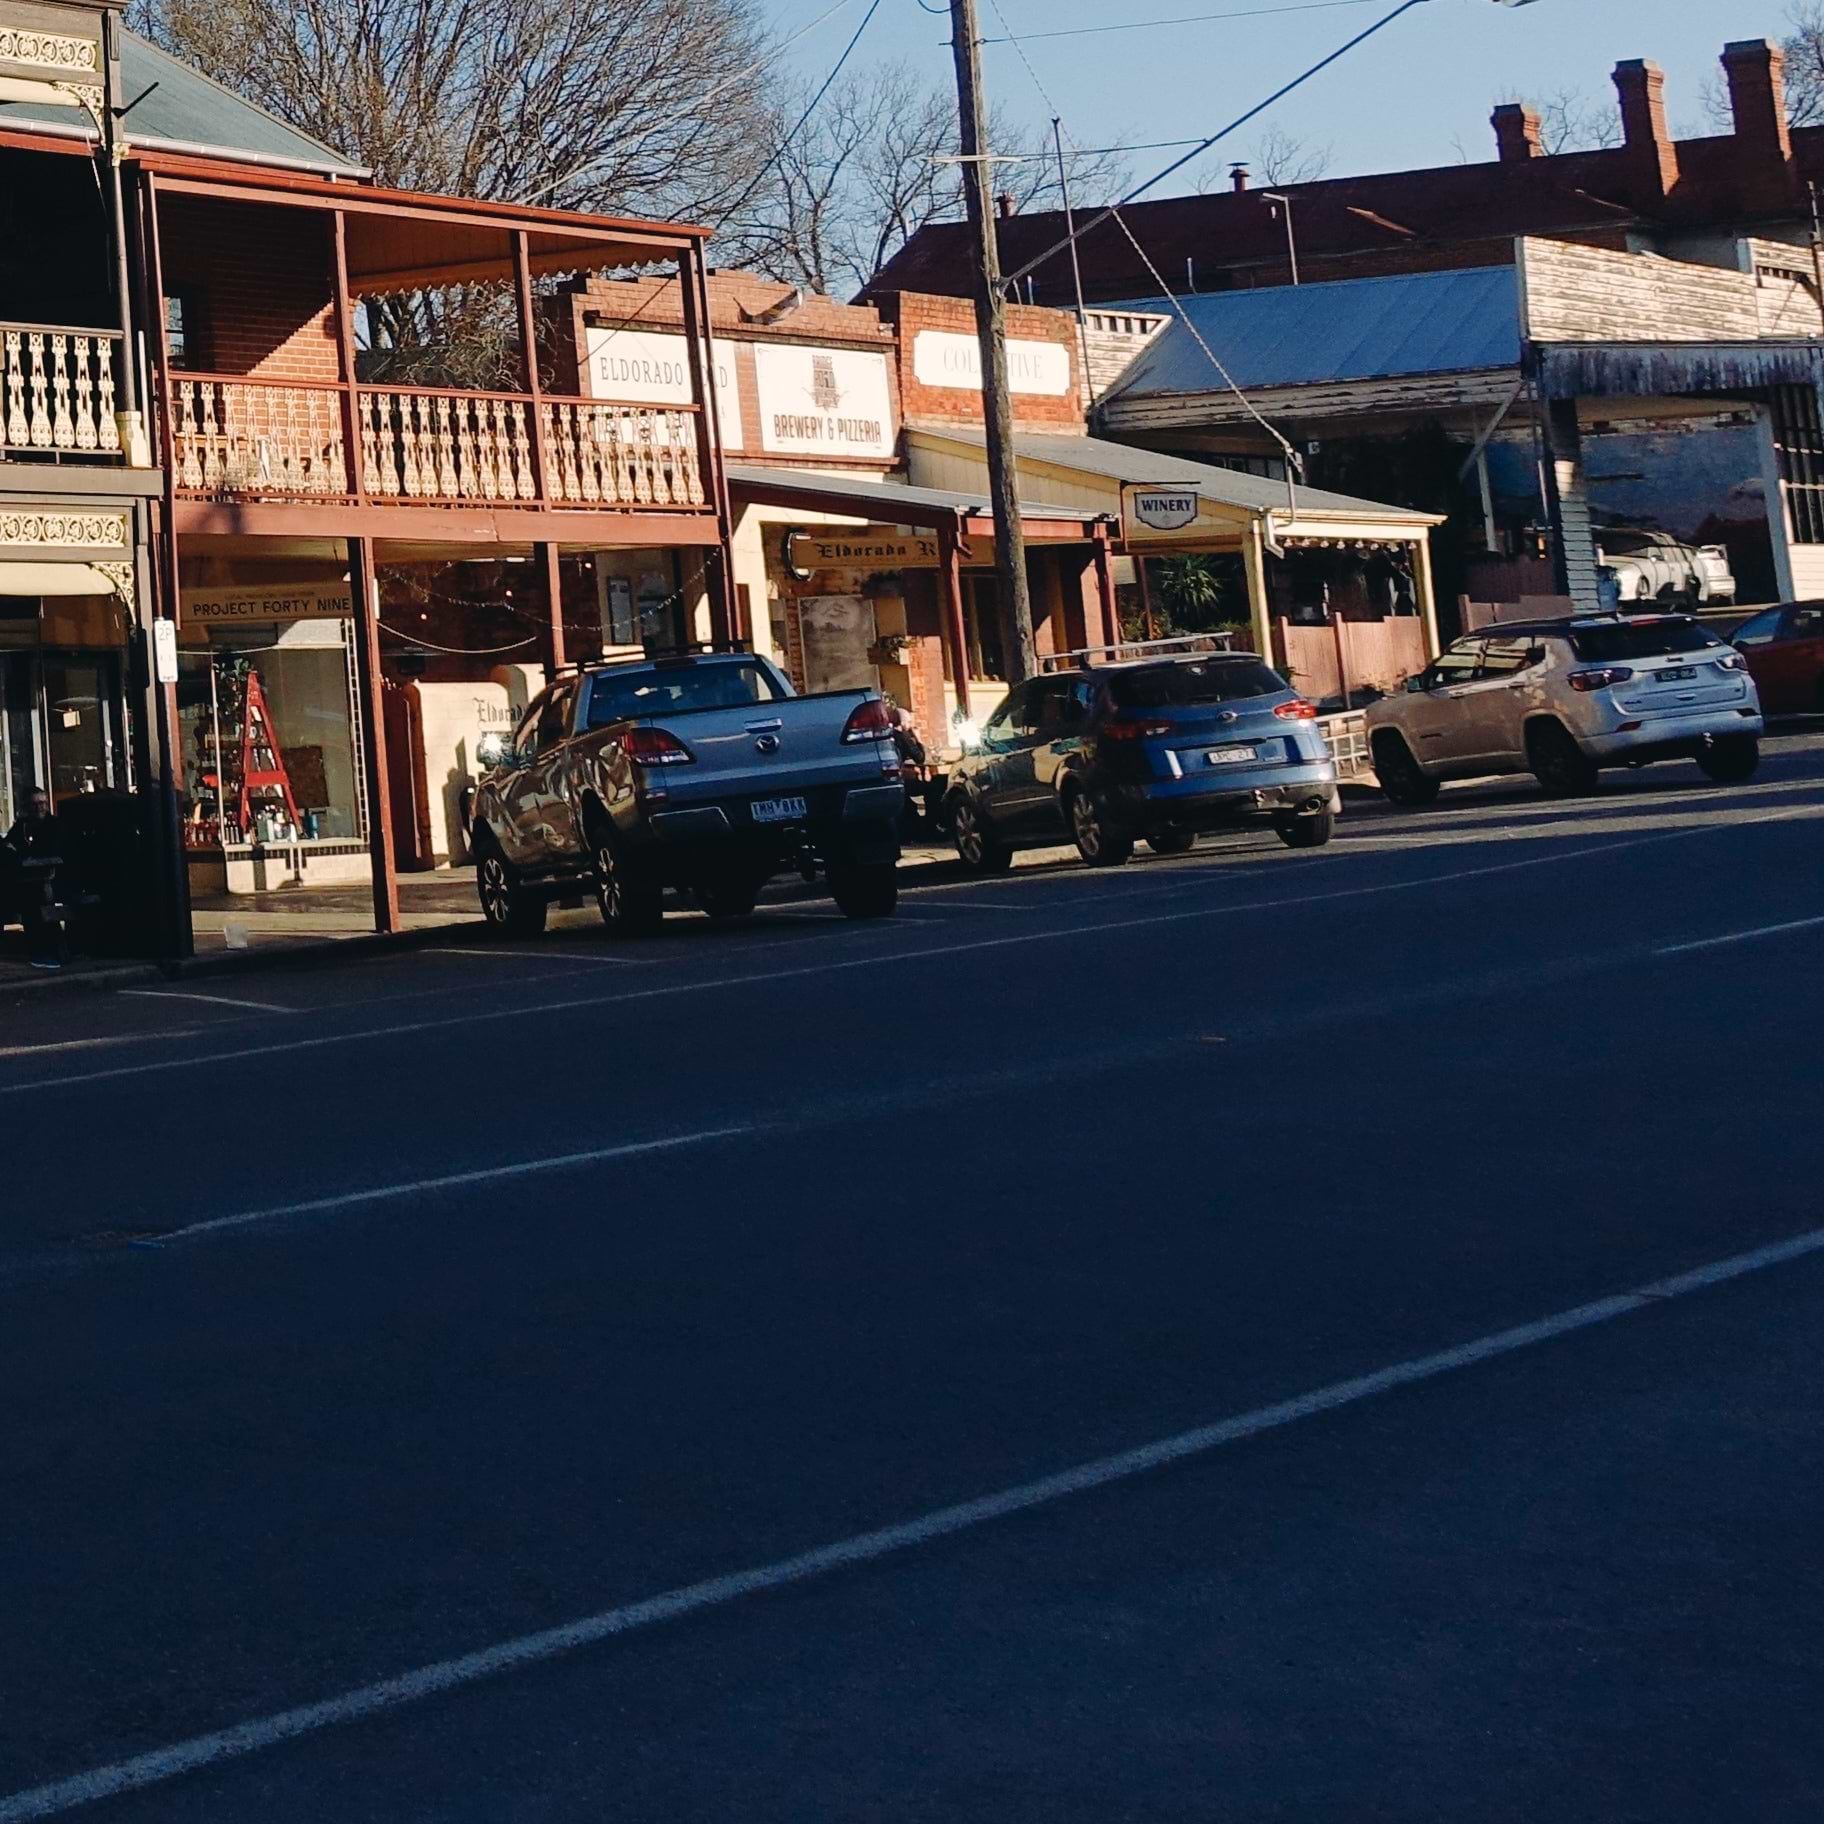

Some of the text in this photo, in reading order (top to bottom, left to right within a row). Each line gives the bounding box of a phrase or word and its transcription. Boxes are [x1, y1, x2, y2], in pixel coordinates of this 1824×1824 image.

[600, 356, 684, 386] ELDORADO
[773, 414, 824, 440] BREWERY
[837, 418, 882, 443] PIZZERIA
[1141, 499, 1192, 512] WINERY
[814, 542, 907, 559] Eldorado
[193, 597, 350, 617] PROJECT FORTY NINE
